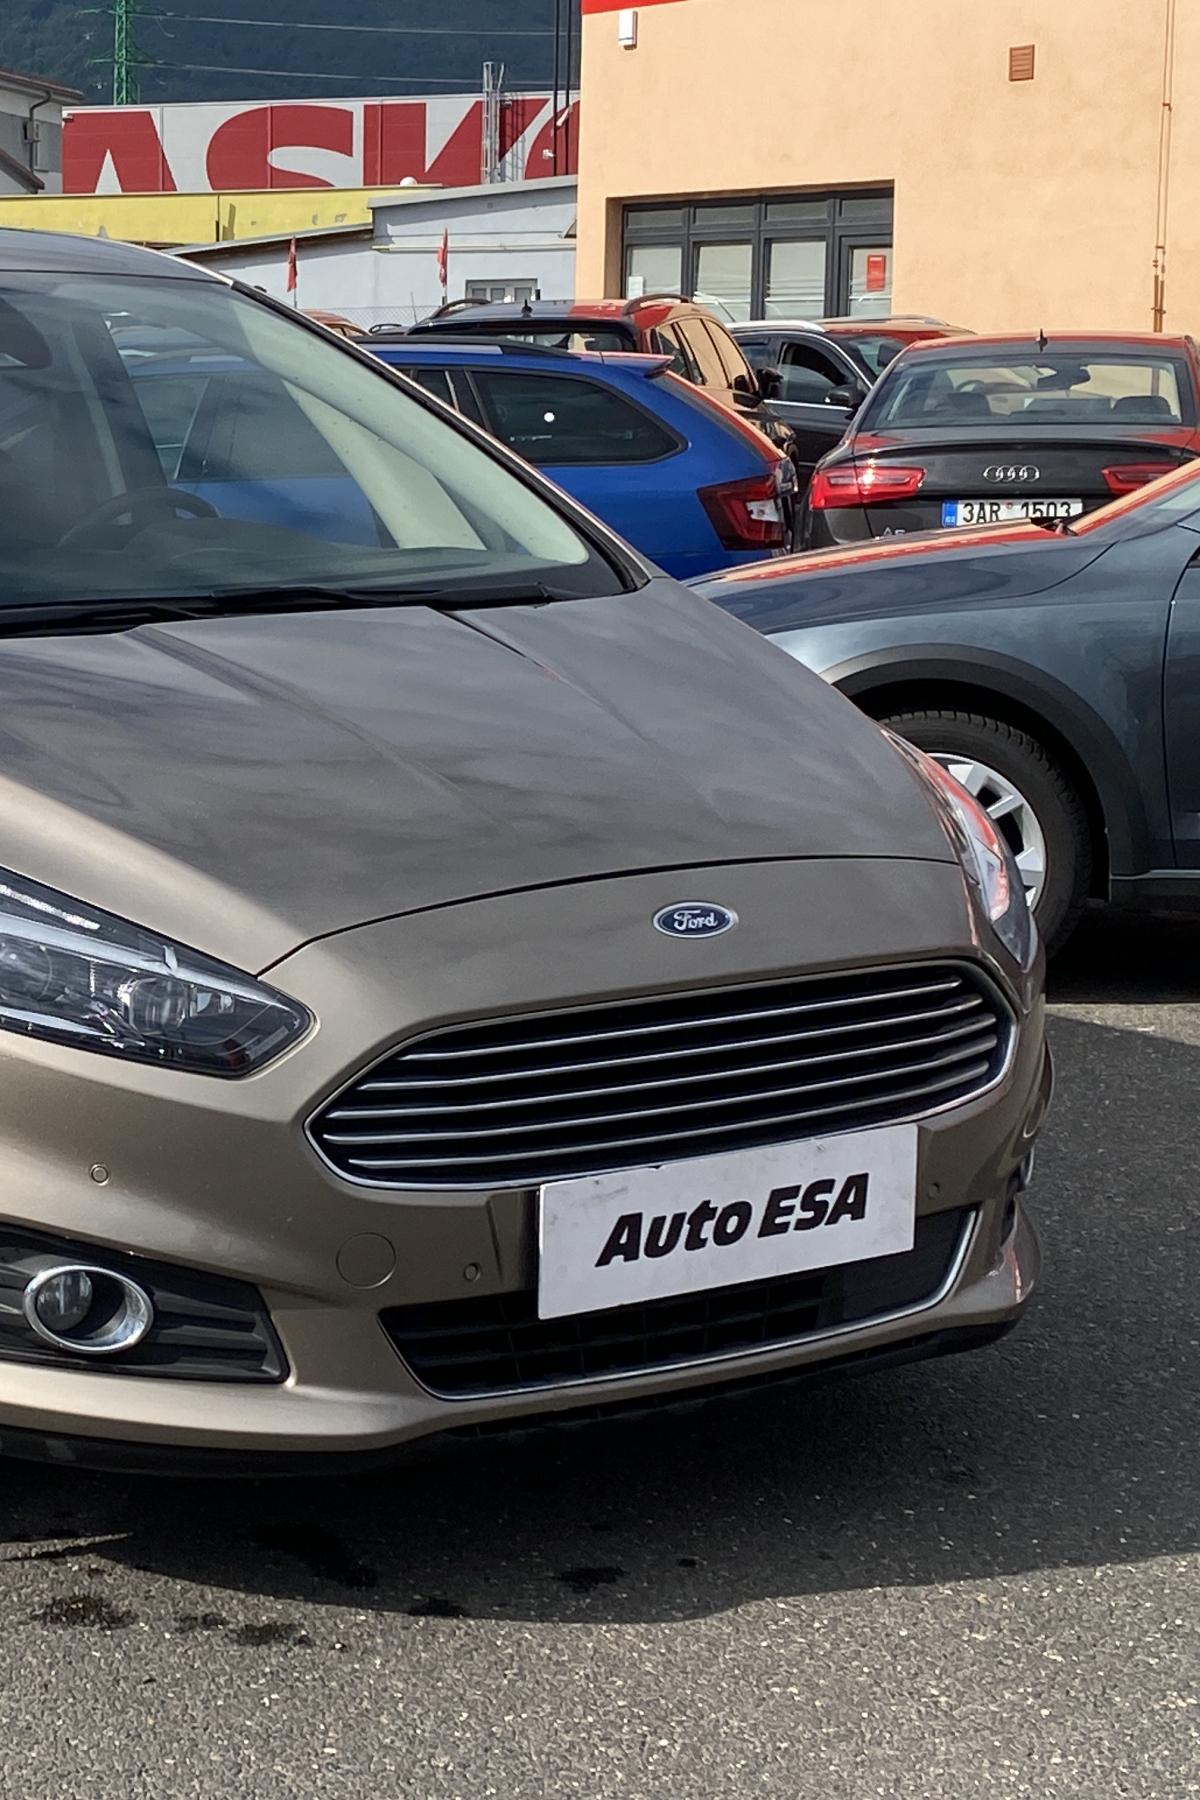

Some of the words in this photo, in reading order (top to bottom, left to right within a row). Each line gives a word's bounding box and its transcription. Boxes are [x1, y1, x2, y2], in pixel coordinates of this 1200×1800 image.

[62, 97, 579, 194] ASK
[962, 502, 1000, 523] 3AR
[1021, 502, 1071, 518] 1503
[673, 909, 719, 931] Ford
[595, 1200, 753, 1268] Auto
[757, 1172, 870, 1238] ESA
